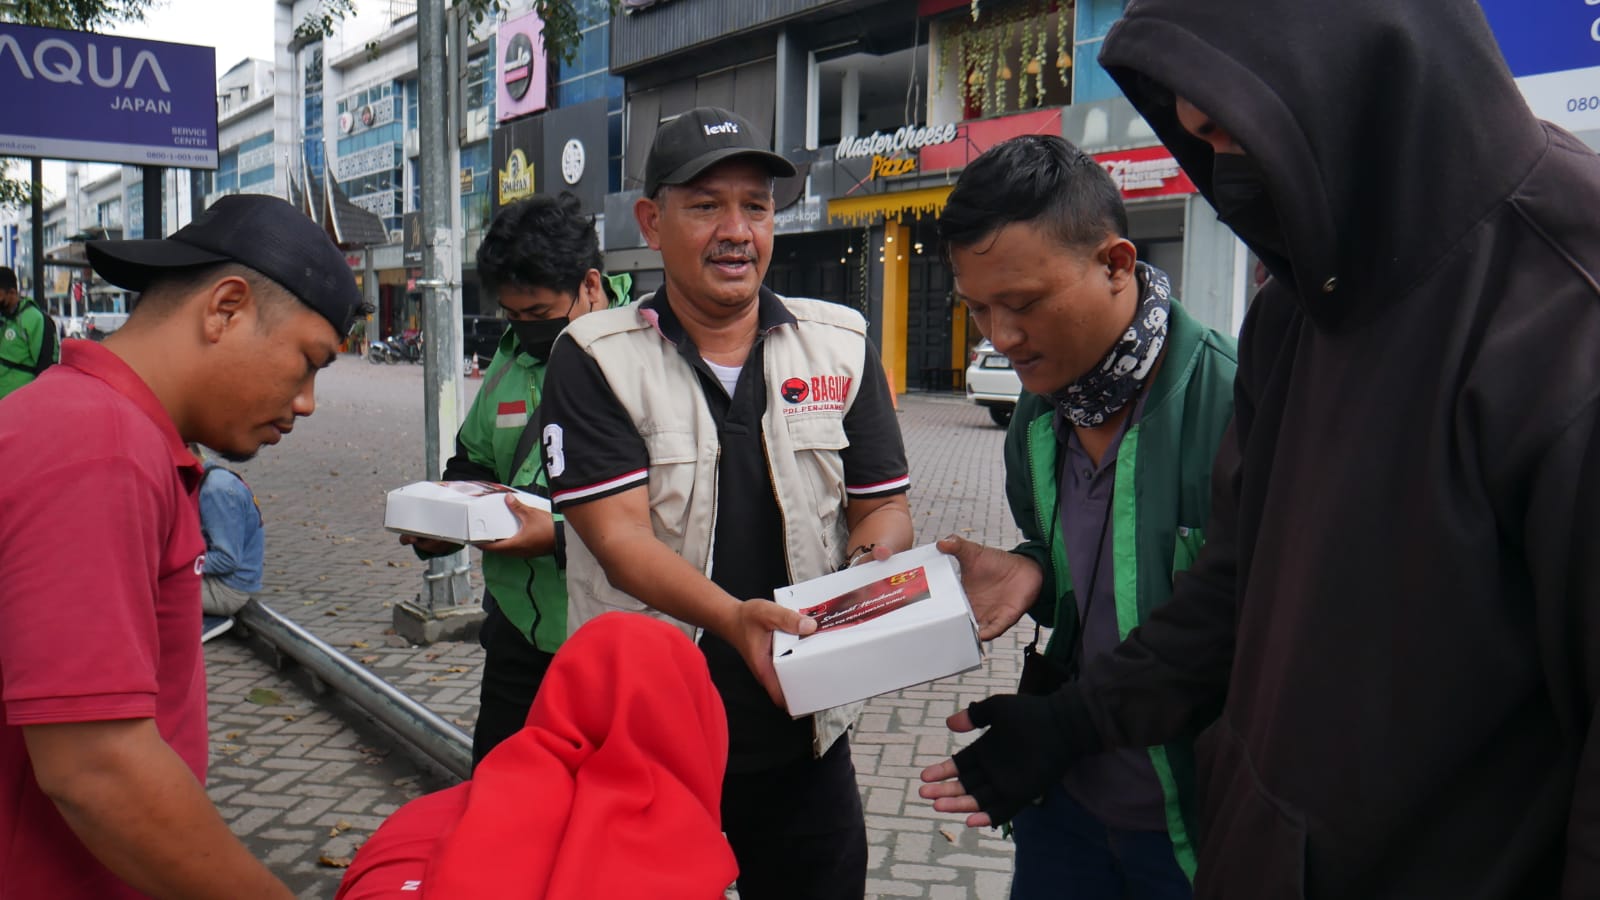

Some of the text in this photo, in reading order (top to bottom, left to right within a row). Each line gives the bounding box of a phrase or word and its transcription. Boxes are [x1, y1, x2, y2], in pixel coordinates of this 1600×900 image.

[0, 34, 171, 93] AQUA
[110, 96, 171, 115] JAPAN
[171, 127, 207, 137] SERVICE
[174, 136, 208, 146] CENTER
[835, 122, 957, 160] MasterCheese
[869, 154, 915, 181] Pizza
[543, 423, 566, 479] 3
